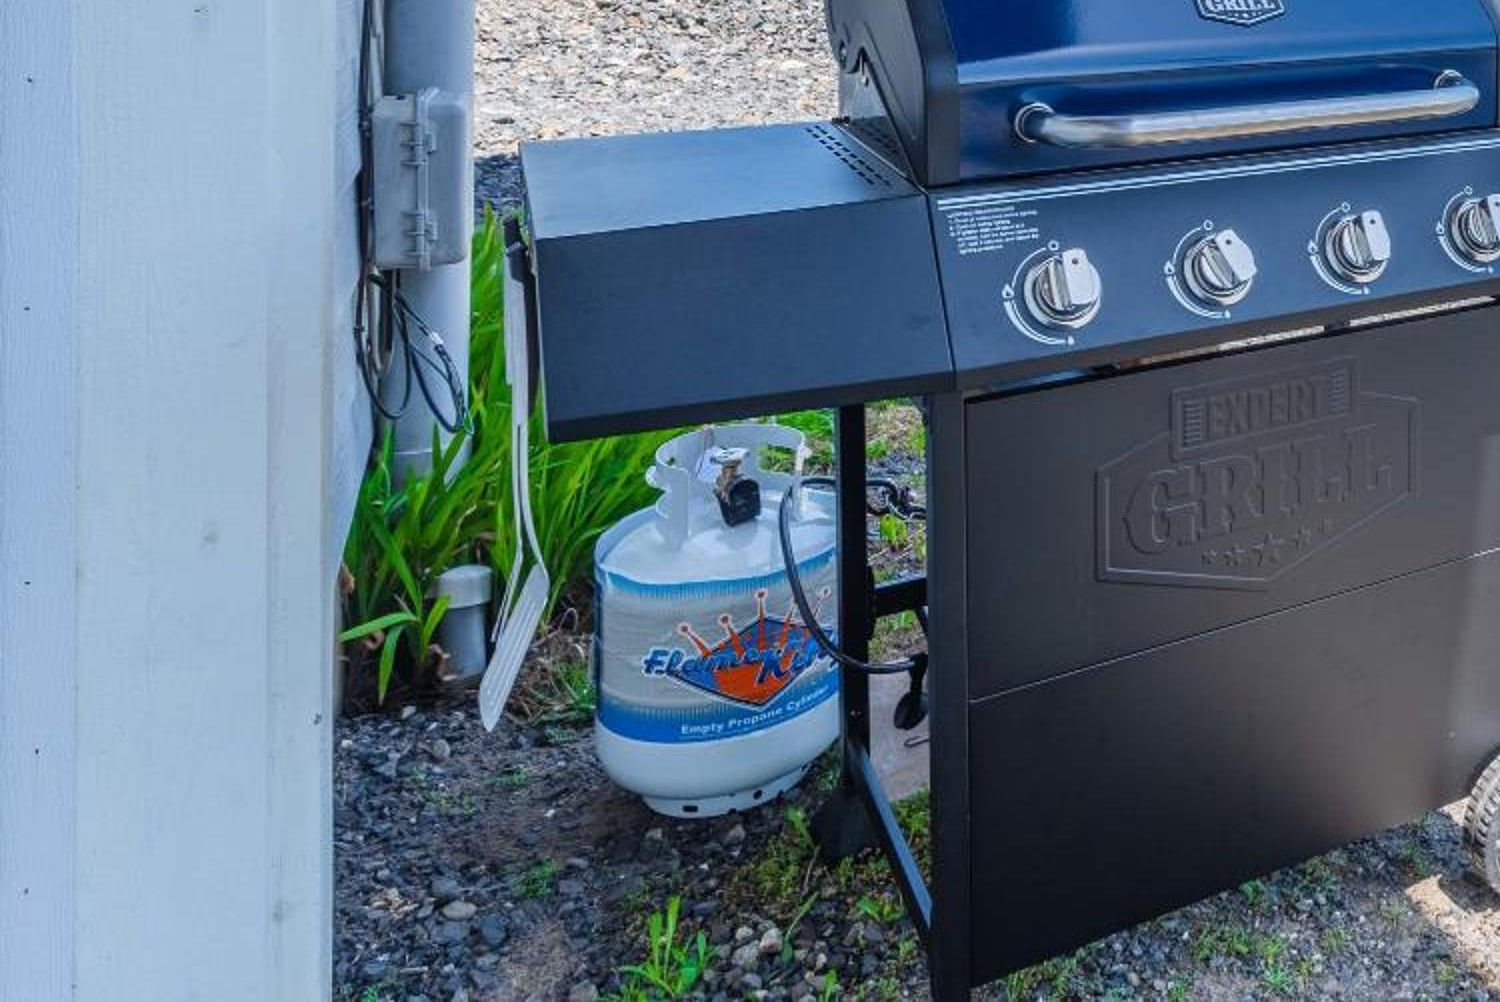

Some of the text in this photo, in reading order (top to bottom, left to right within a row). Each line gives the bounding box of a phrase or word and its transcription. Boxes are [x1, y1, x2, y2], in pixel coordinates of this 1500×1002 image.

[1206, 376, 1328, 438] EXPERT
[1123, 424, 1393, 555] GRILL
[681, 721, 725, 736] Empty
[728, 708, 783, 728] Propane
